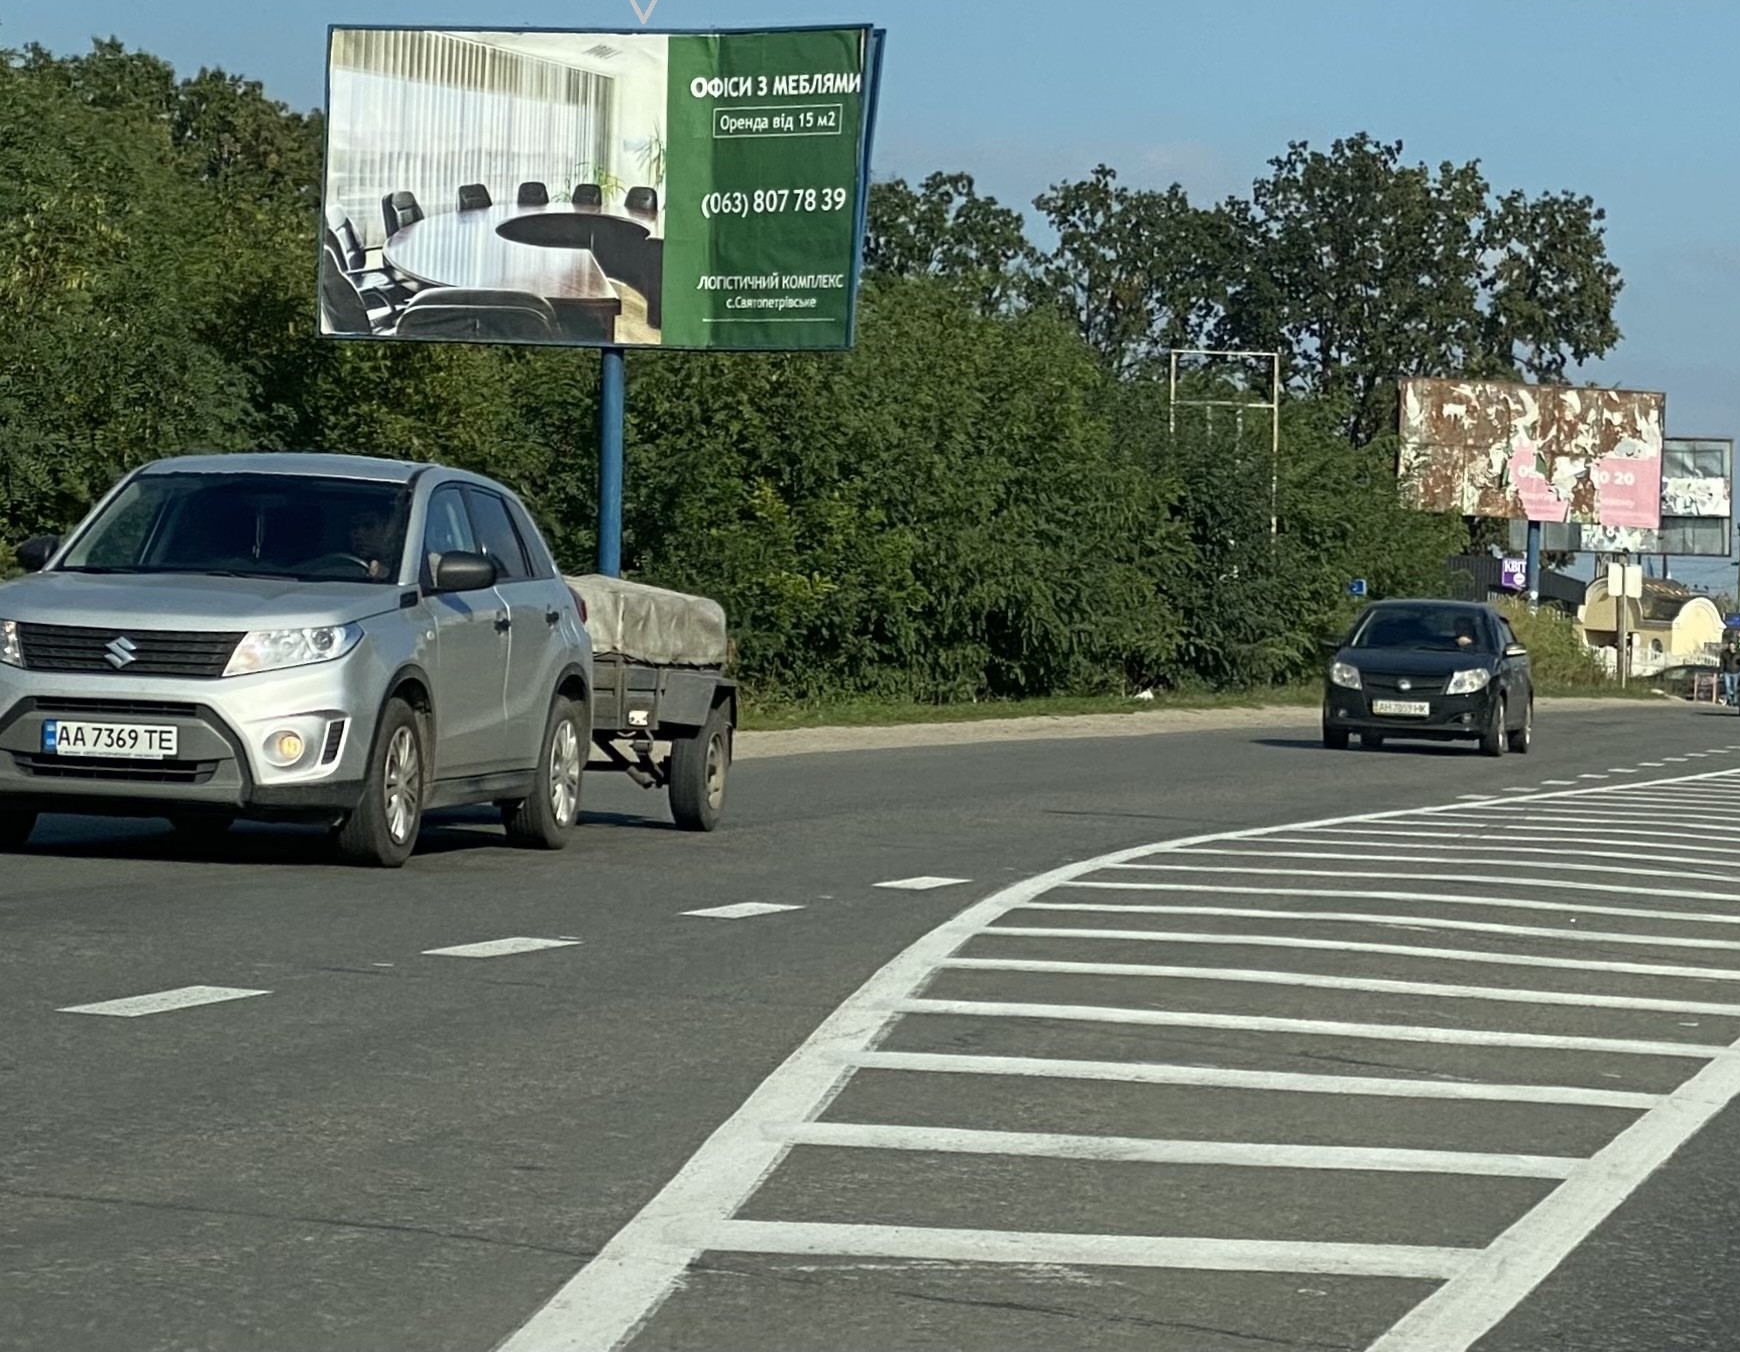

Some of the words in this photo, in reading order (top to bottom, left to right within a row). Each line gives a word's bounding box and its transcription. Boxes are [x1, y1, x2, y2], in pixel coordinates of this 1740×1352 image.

[690, 76, 752, 98] ОФІСИ
[773, 72, 862, 96] МЕБЛЯМИ
[720, 114, 769, 132] Оренда
[772, 113, 794, 131] від
[799, 112, 813, 127] 15
[817, 112, 836, 127] м2
[701, 192, 748, 219] (063)
[753, 189, 789, 213] 807
[793, 189, 816, 211] 78
[821, 187, 846, 211] 39
[697, 272, 779, 290] ЛОГІСТИЧНИЙ
[782, 274, 844, 289] КОМПЛЕКС
[58, 726, 86, 746] AA
[92, 727, 138, 749] 7369
[144, 730, 173, 750] TE
